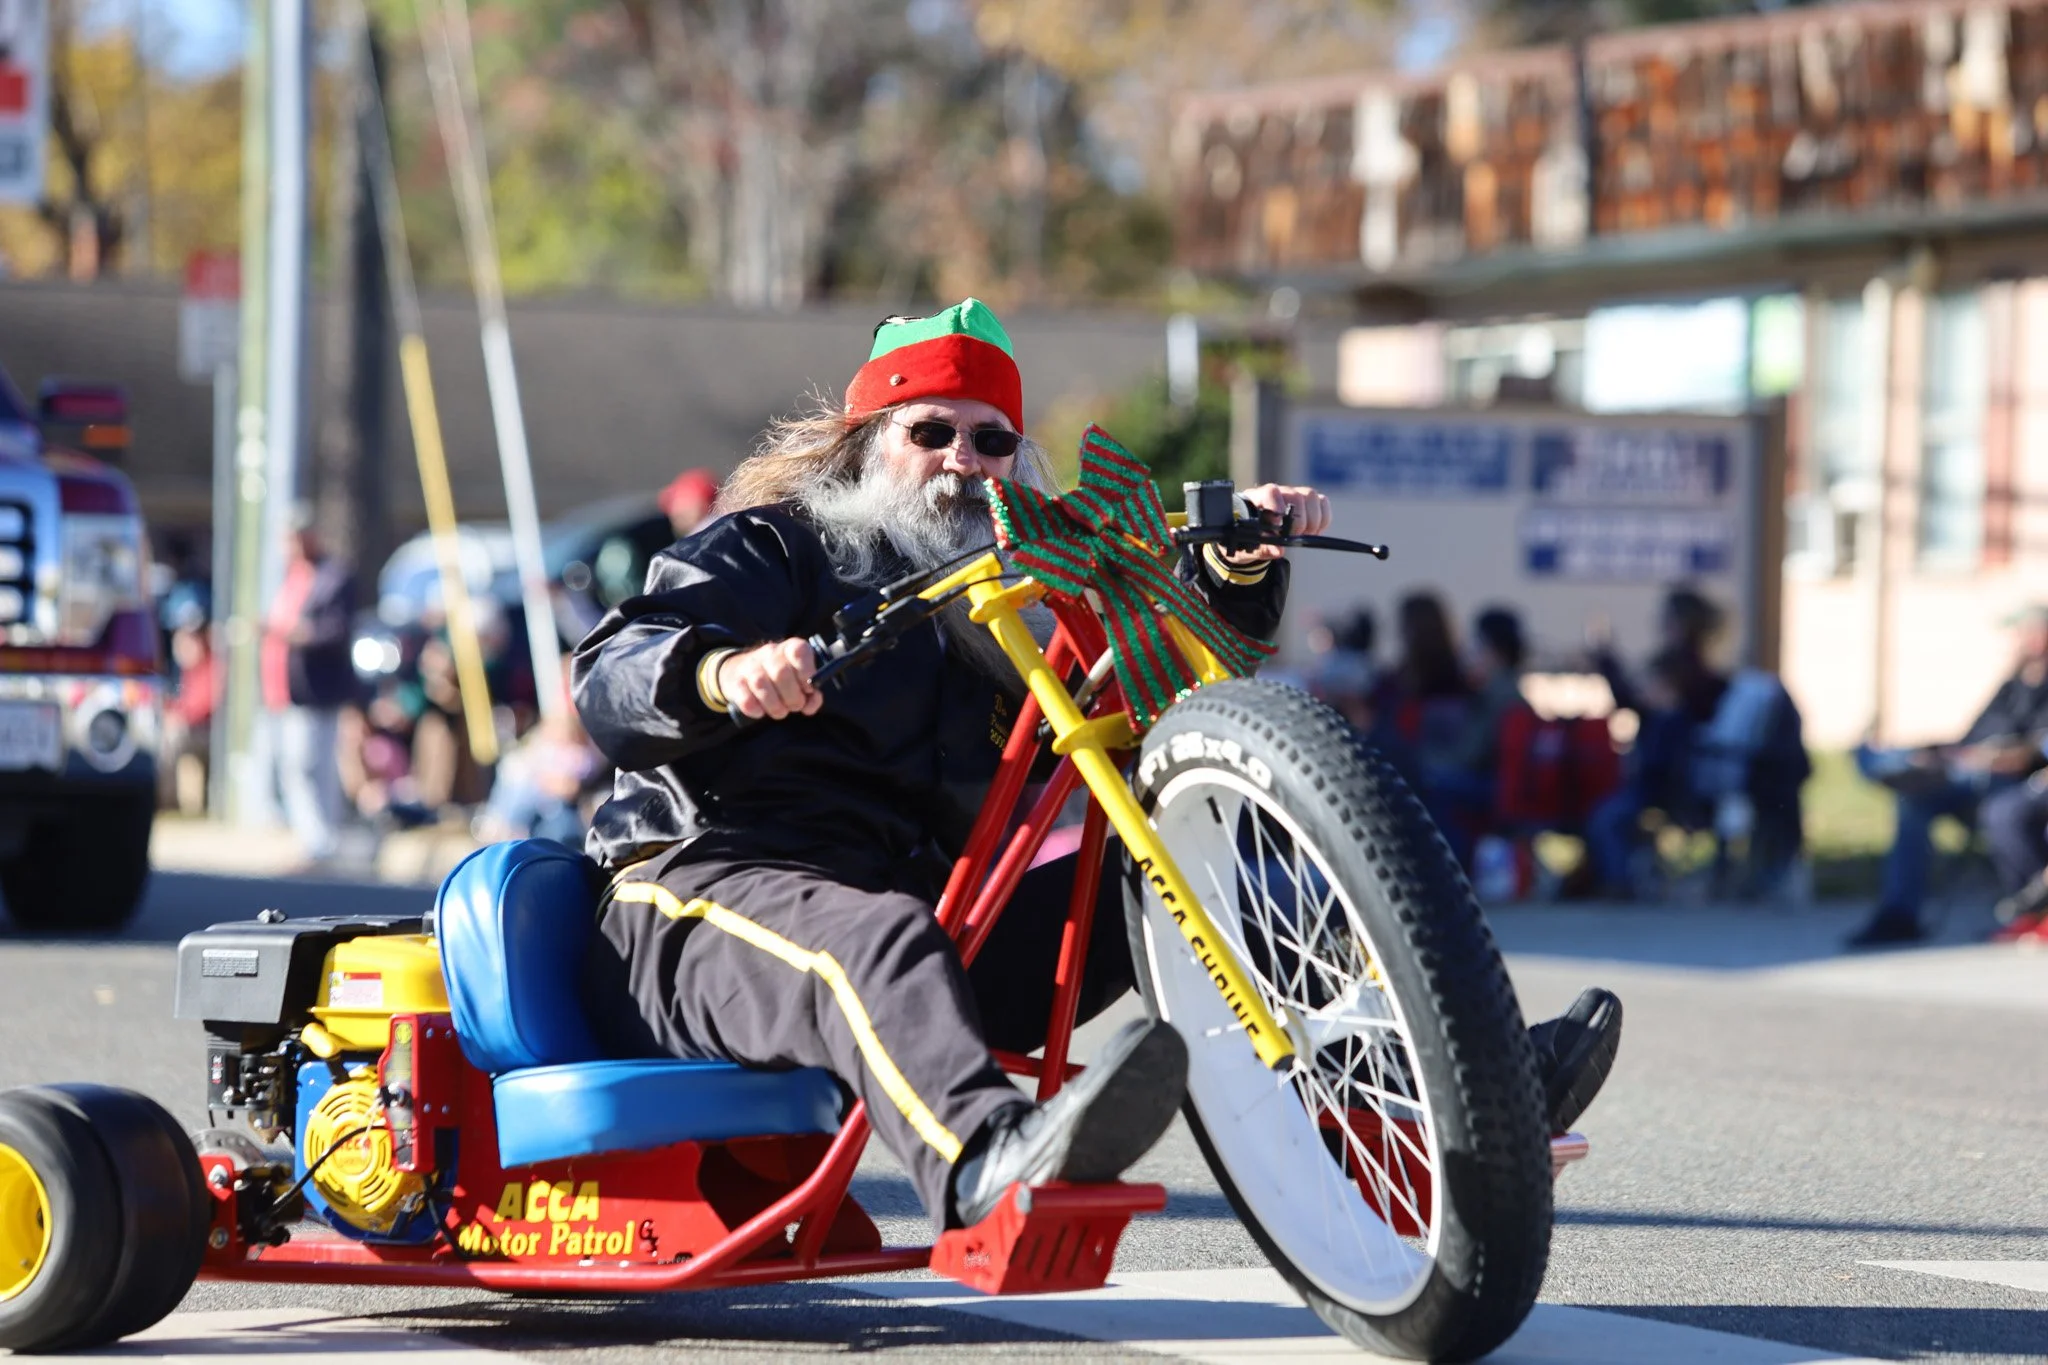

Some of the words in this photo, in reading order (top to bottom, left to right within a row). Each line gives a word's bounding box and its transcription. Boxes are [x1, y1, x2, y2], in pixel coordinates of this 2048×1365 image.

[492, 1180, 600, 1223] ACCA
[458, 1223, 542, 1256] Motor
[547, 1220, 636, 1256] Patrol
